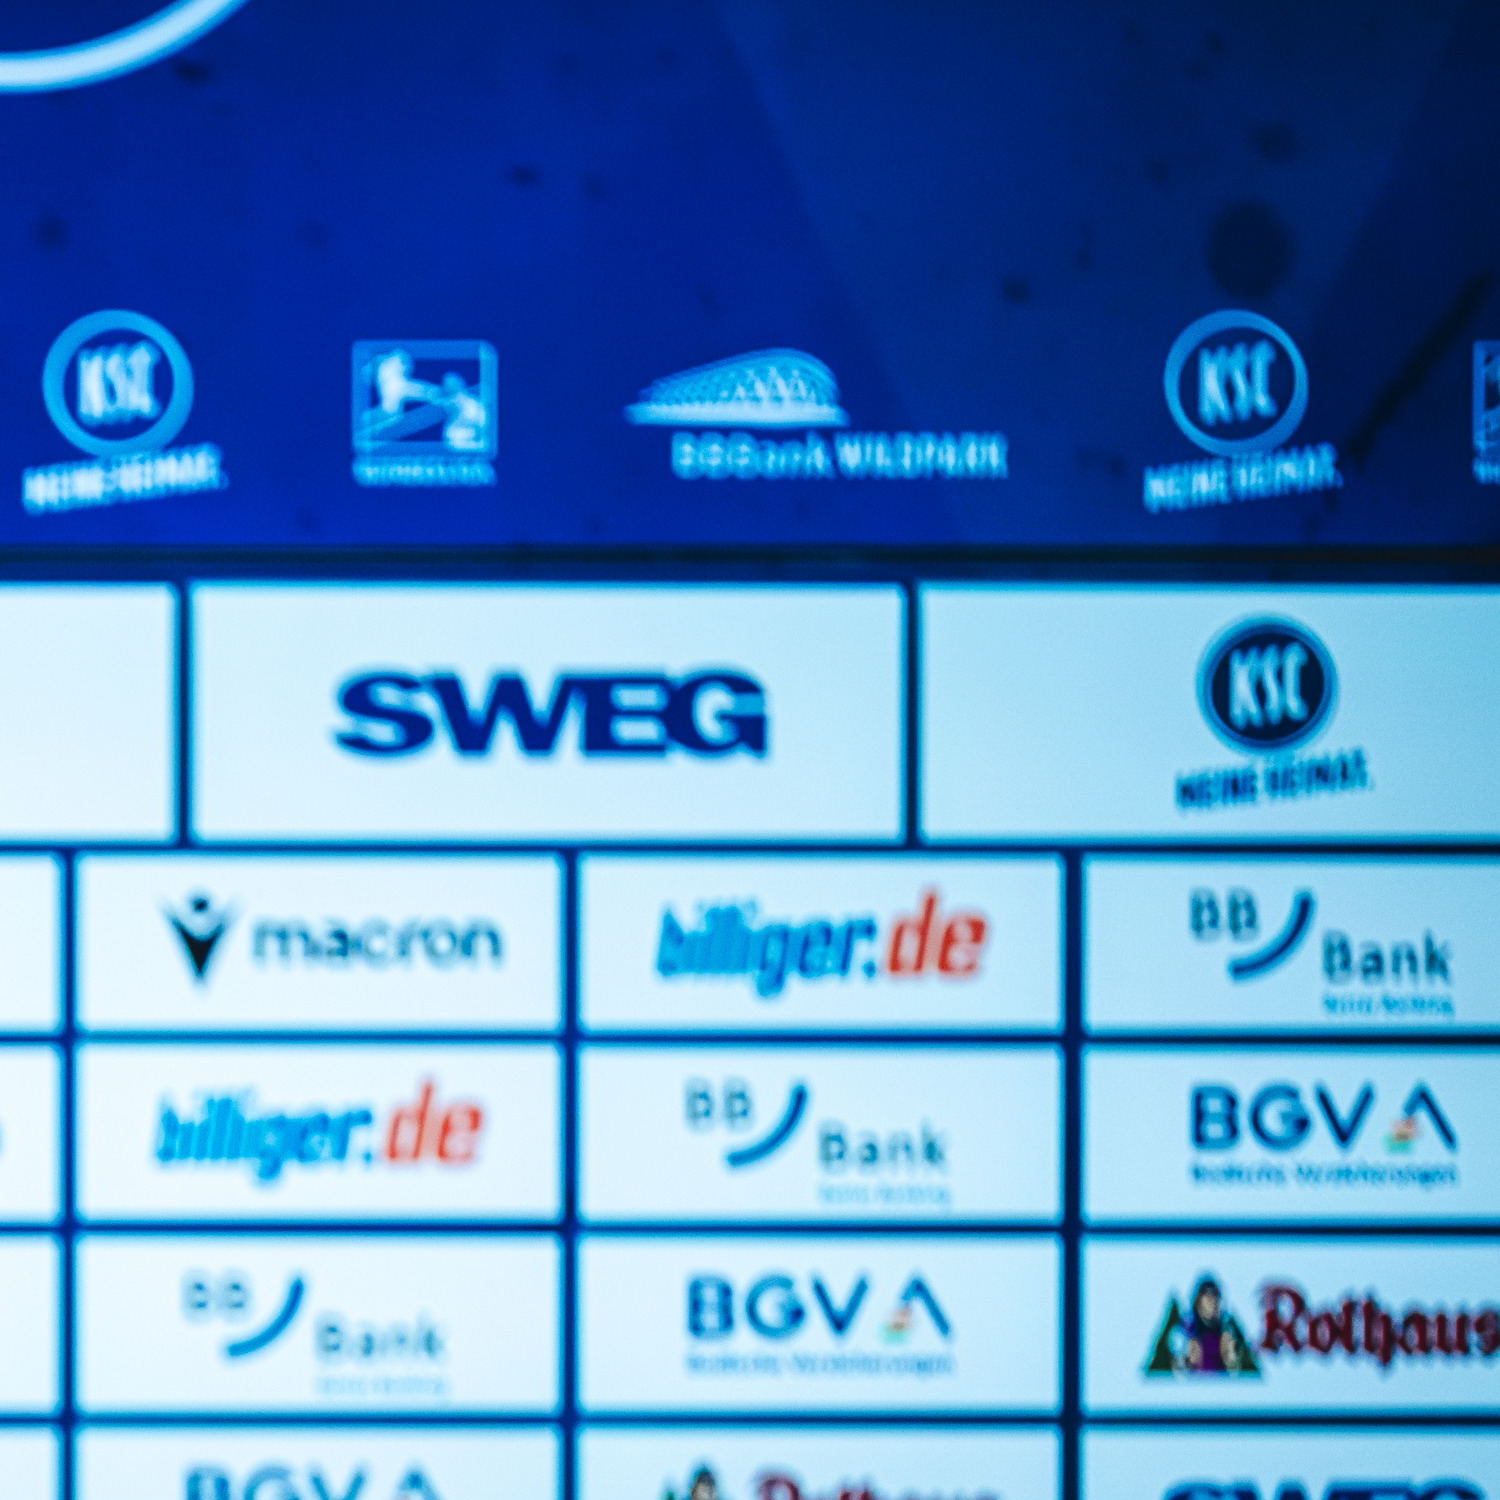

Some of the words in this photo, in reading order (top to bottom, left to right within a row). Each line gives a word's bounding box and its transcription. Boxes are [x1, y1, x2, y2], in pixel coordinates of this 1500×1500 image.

[334, 666, 770, 762] SWEG
[1228, 638, 1311, 729] KSC
[253, 915, 505, 969] macron
[656, 887, 988, 998] billiger.de
[1322, 931, 1453, 985] Bank
[153, 1075, 484, 1190] billiger.de
[817, 1122, 949, 1175] Bank
